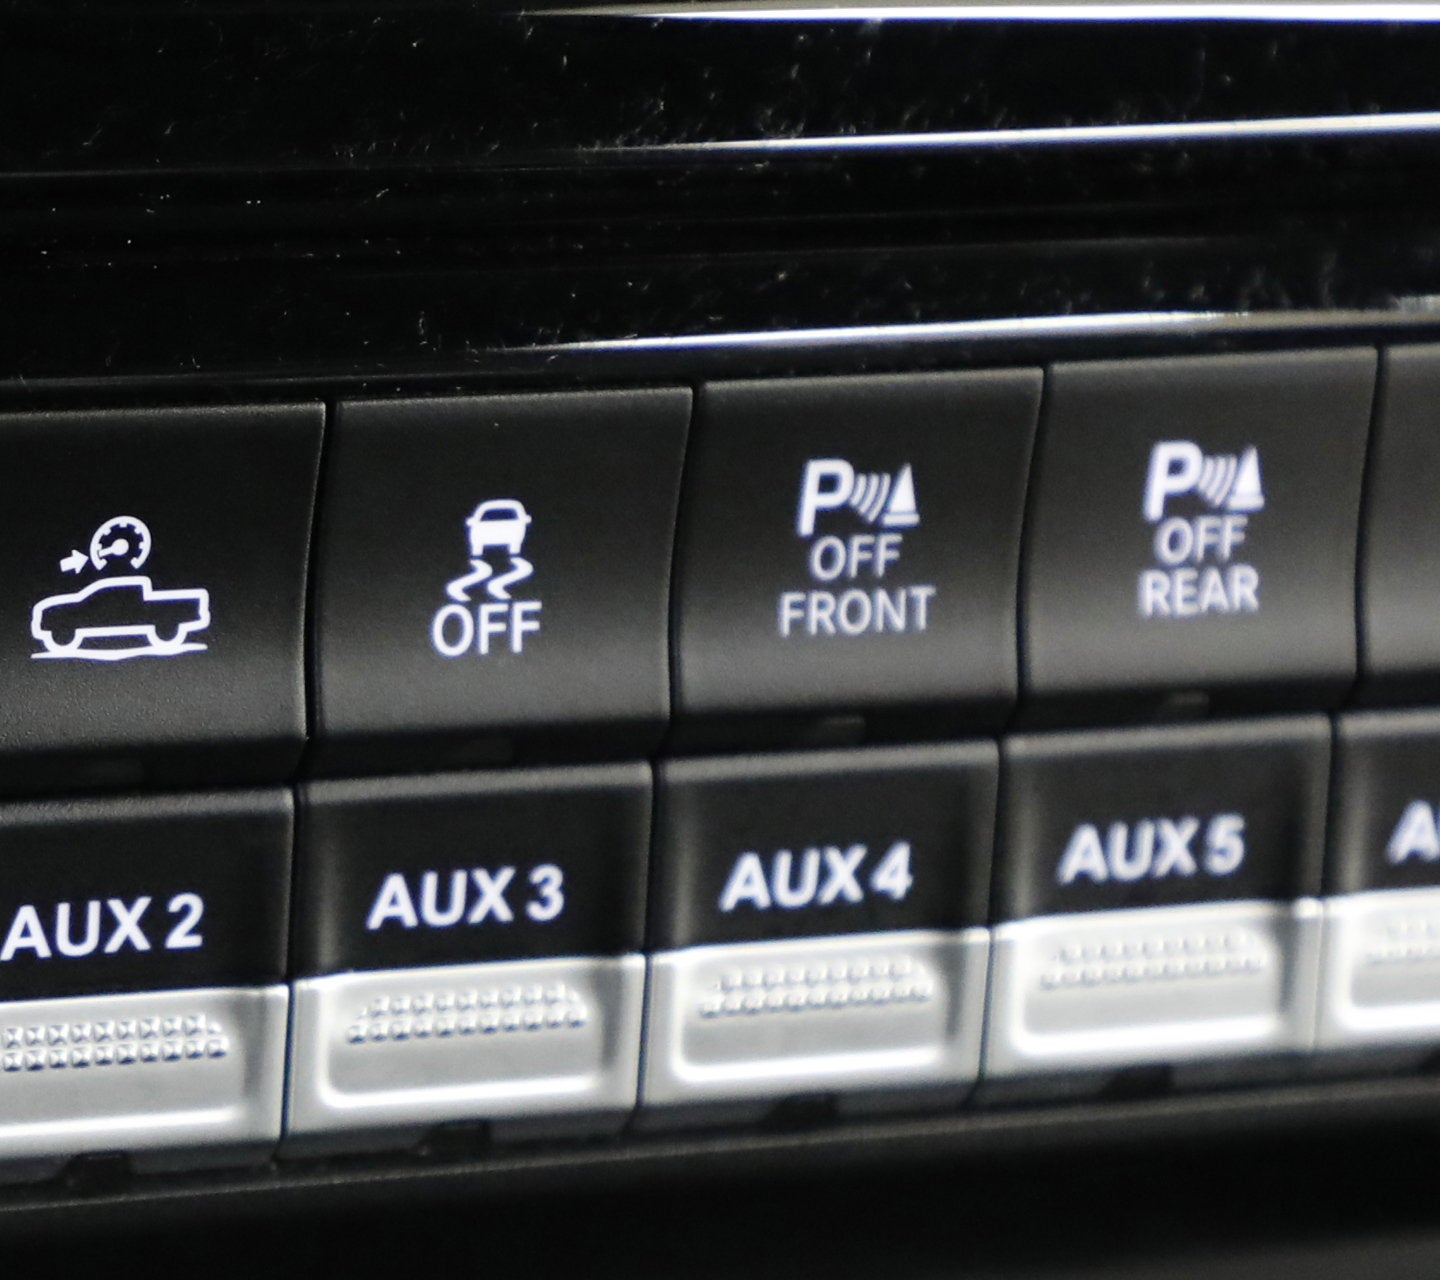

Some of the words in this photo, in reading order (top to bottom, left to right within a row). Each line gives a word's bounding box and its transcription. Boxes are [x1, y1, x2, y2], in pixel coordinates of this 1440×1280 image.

[811, 534, 901, 581] OFF
[1157, 516, 1246, 564] OFF
[780, 587, 934, 636] FRONT
[1141, 567, 1258, 615] REAR
[432, 601, 541, 657] OFF
[721, 846, 866, 910] AUX
[872, 843, 912, 898] 4
[1060, 819, 1197, 882] AUX
[1207, 816, 1243, 873] 5
[368, 868, 514, 929] AUX
[527, 865, 563, 921] 3
[0, 897, 150, 960] AUX
[166, 893, 203, 948] 2
